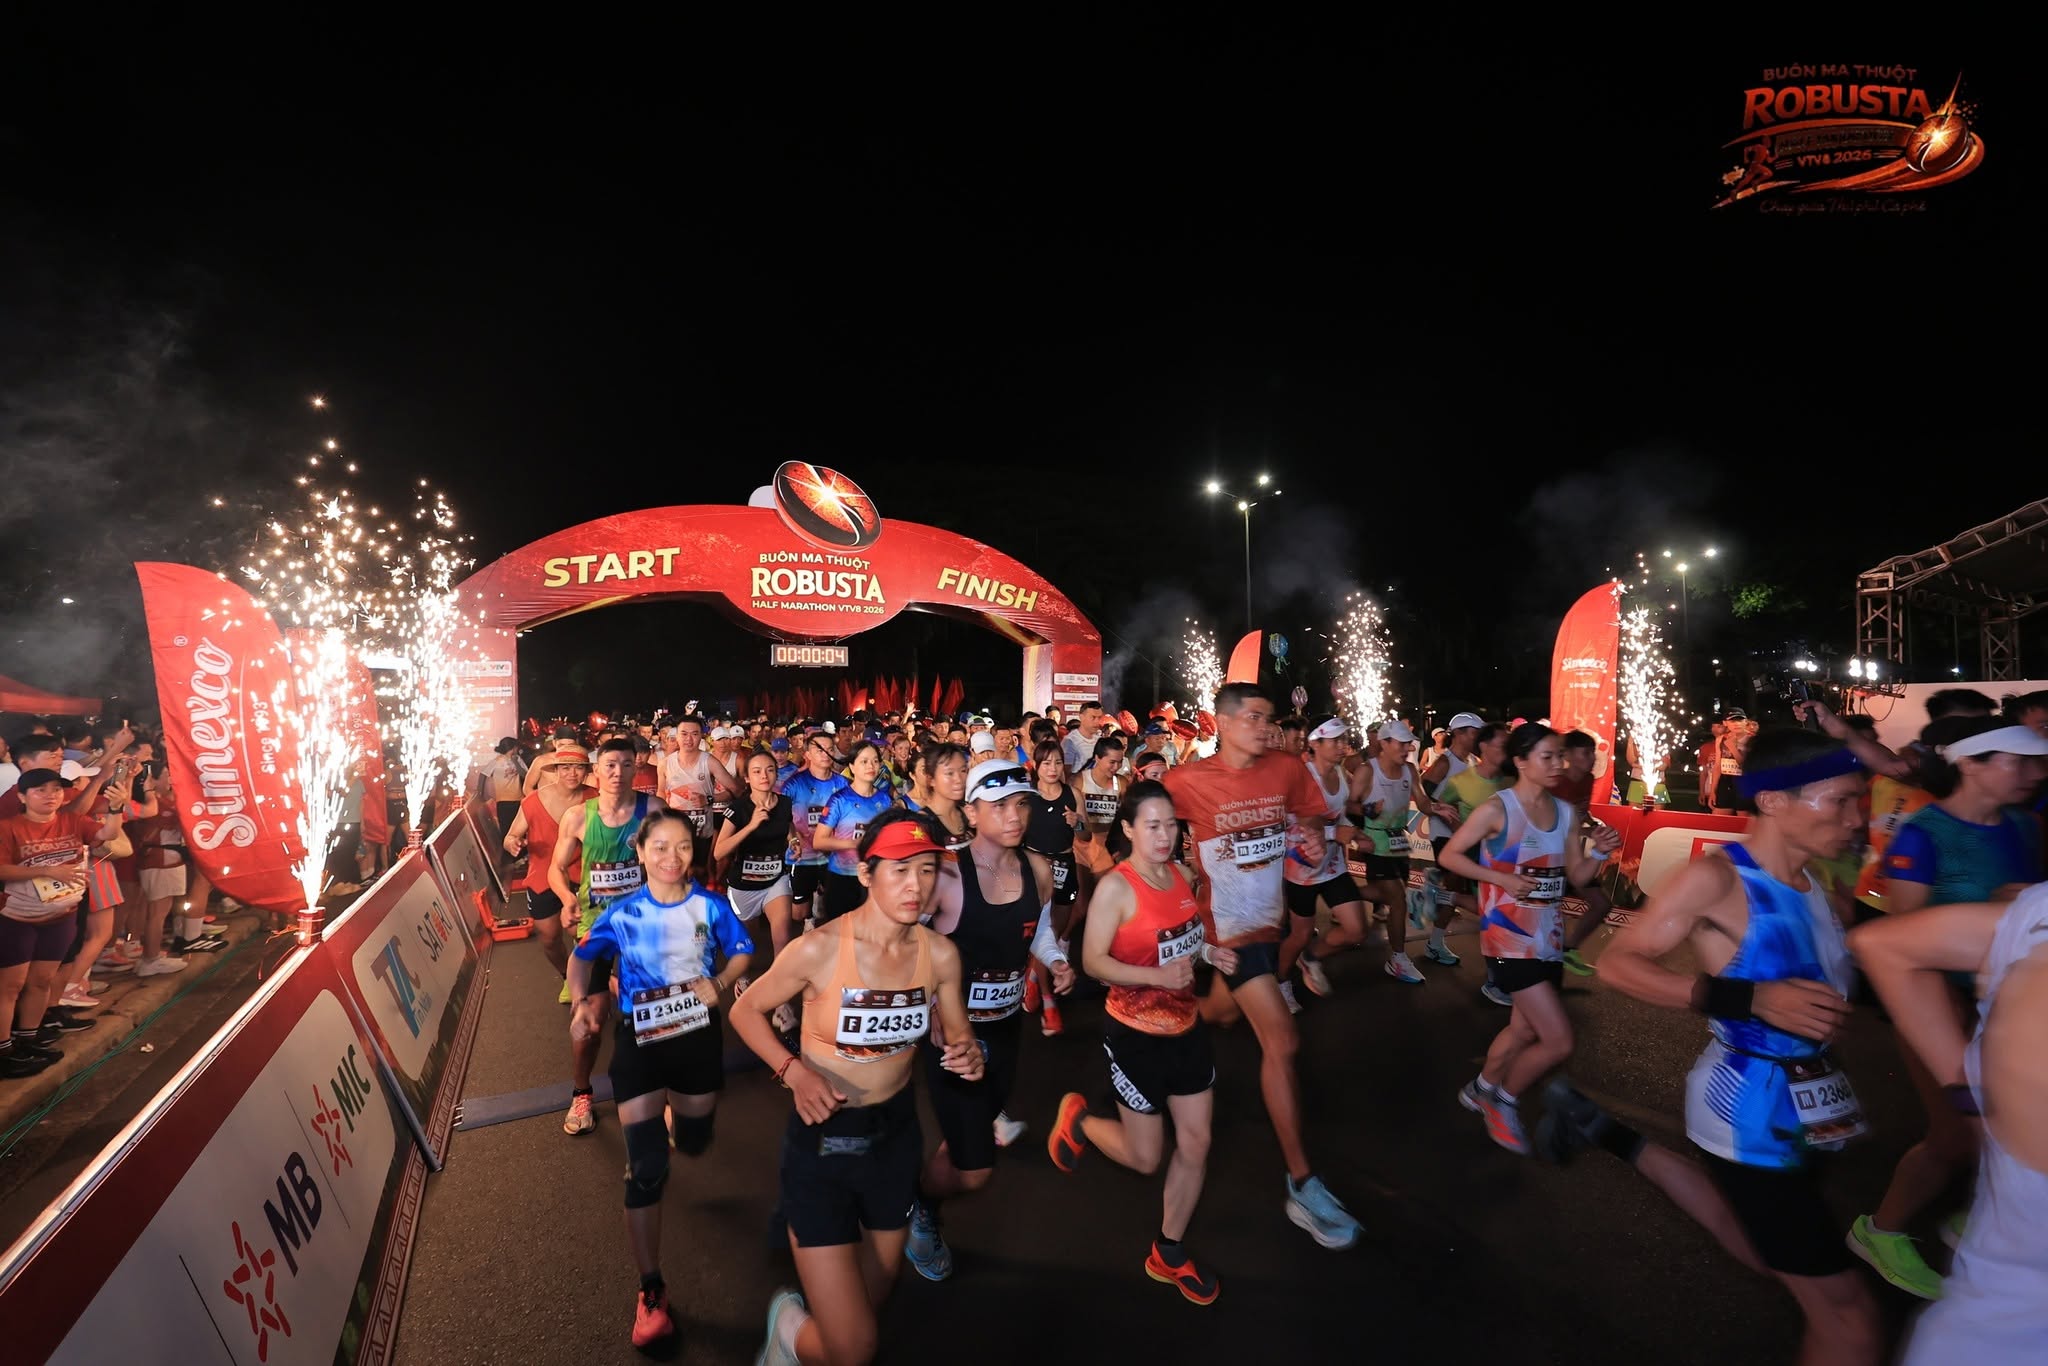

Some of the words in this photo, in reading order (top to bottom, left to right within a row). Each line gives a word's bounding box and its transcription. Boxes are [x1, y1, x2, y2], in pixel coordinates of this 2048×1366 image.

[543, 546, 680, 588] START
[759, 550, 798, 564] BUÔN
[801, 553, 824, 564] MA
[825, 554, 870, 571] THUỘT
[751, 566, 886, 604] ROBUSTA
[937, 567, 1039, 612] FINISH
[752, 600, 779, 609] HALF
[780, 601, 836, 612] MARATHON
[838, 604, 861, 613] VTV8
[863, 605, 885, 614] 2026
[776, 646, 845, 663] 00:00:04
[352, 711, 362, 733] 1993
[186, 637, 258, 851] Simexco
[1245, 798, 1258, 807] MA
[1252, 836, 1283, 855] 23915
[604, 869, 638, 882] 23845
[754, 862, 780, 871] 24367
[1176, 929, 1203, 955] 24304
[866, 1012, 923, 1033] 24383
[330, 1043, 371, 1134] MIC
[263, 1151, 323, 1278] MB
